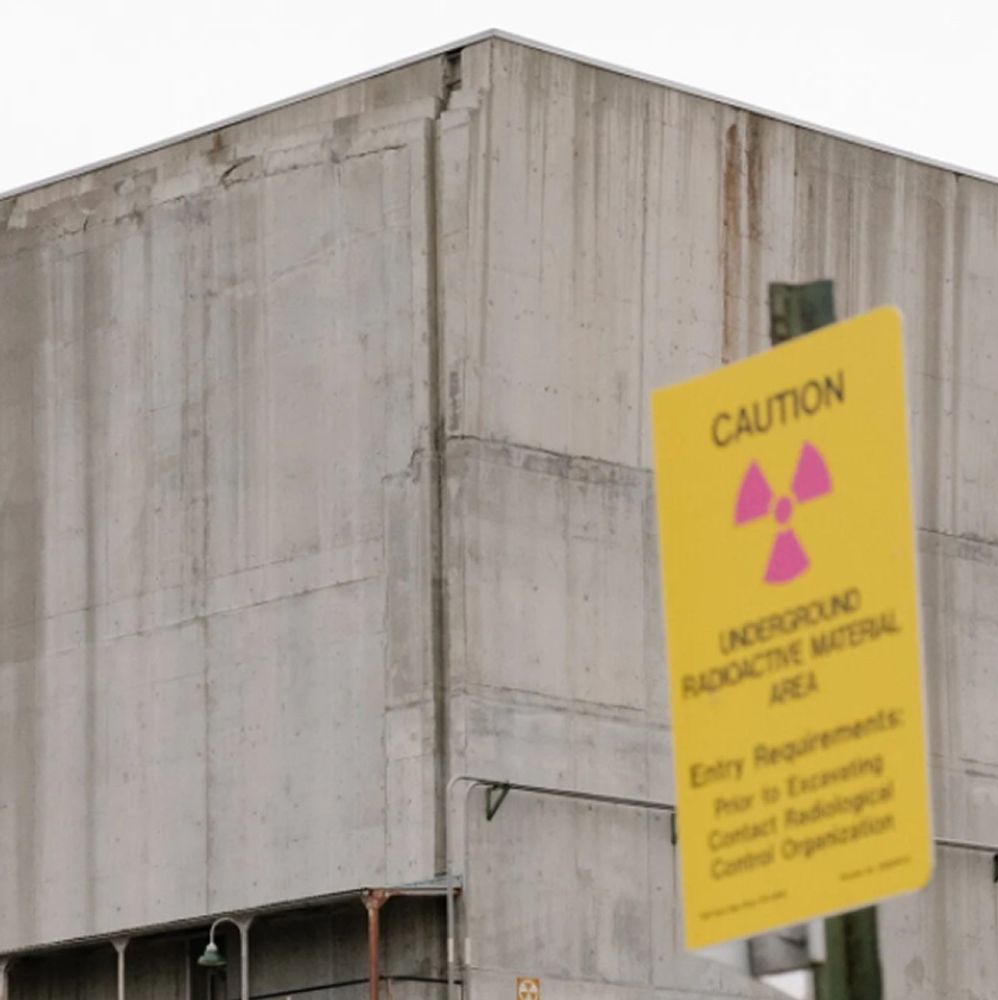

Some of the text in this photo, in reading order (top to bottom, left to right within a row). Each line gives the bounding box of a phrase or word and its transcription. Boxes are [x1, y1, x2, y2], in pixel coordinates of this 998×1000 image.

[711, 371, 846, 448] CAUTION
[719, 586, 861, 655] UNDERGROUND
[682, 611, 901, 700] RADIOACTIVE MATERIAL
[769, 672, 818, 707] AREA
[689, 759, 744, 790] Entry
[714, 794, 754, 817] Prior
[786, 755, 885, 798] Excavating
[707, 782, 895, 852] Contact Radiological
[711, 814, 895, 881] Control Organization
